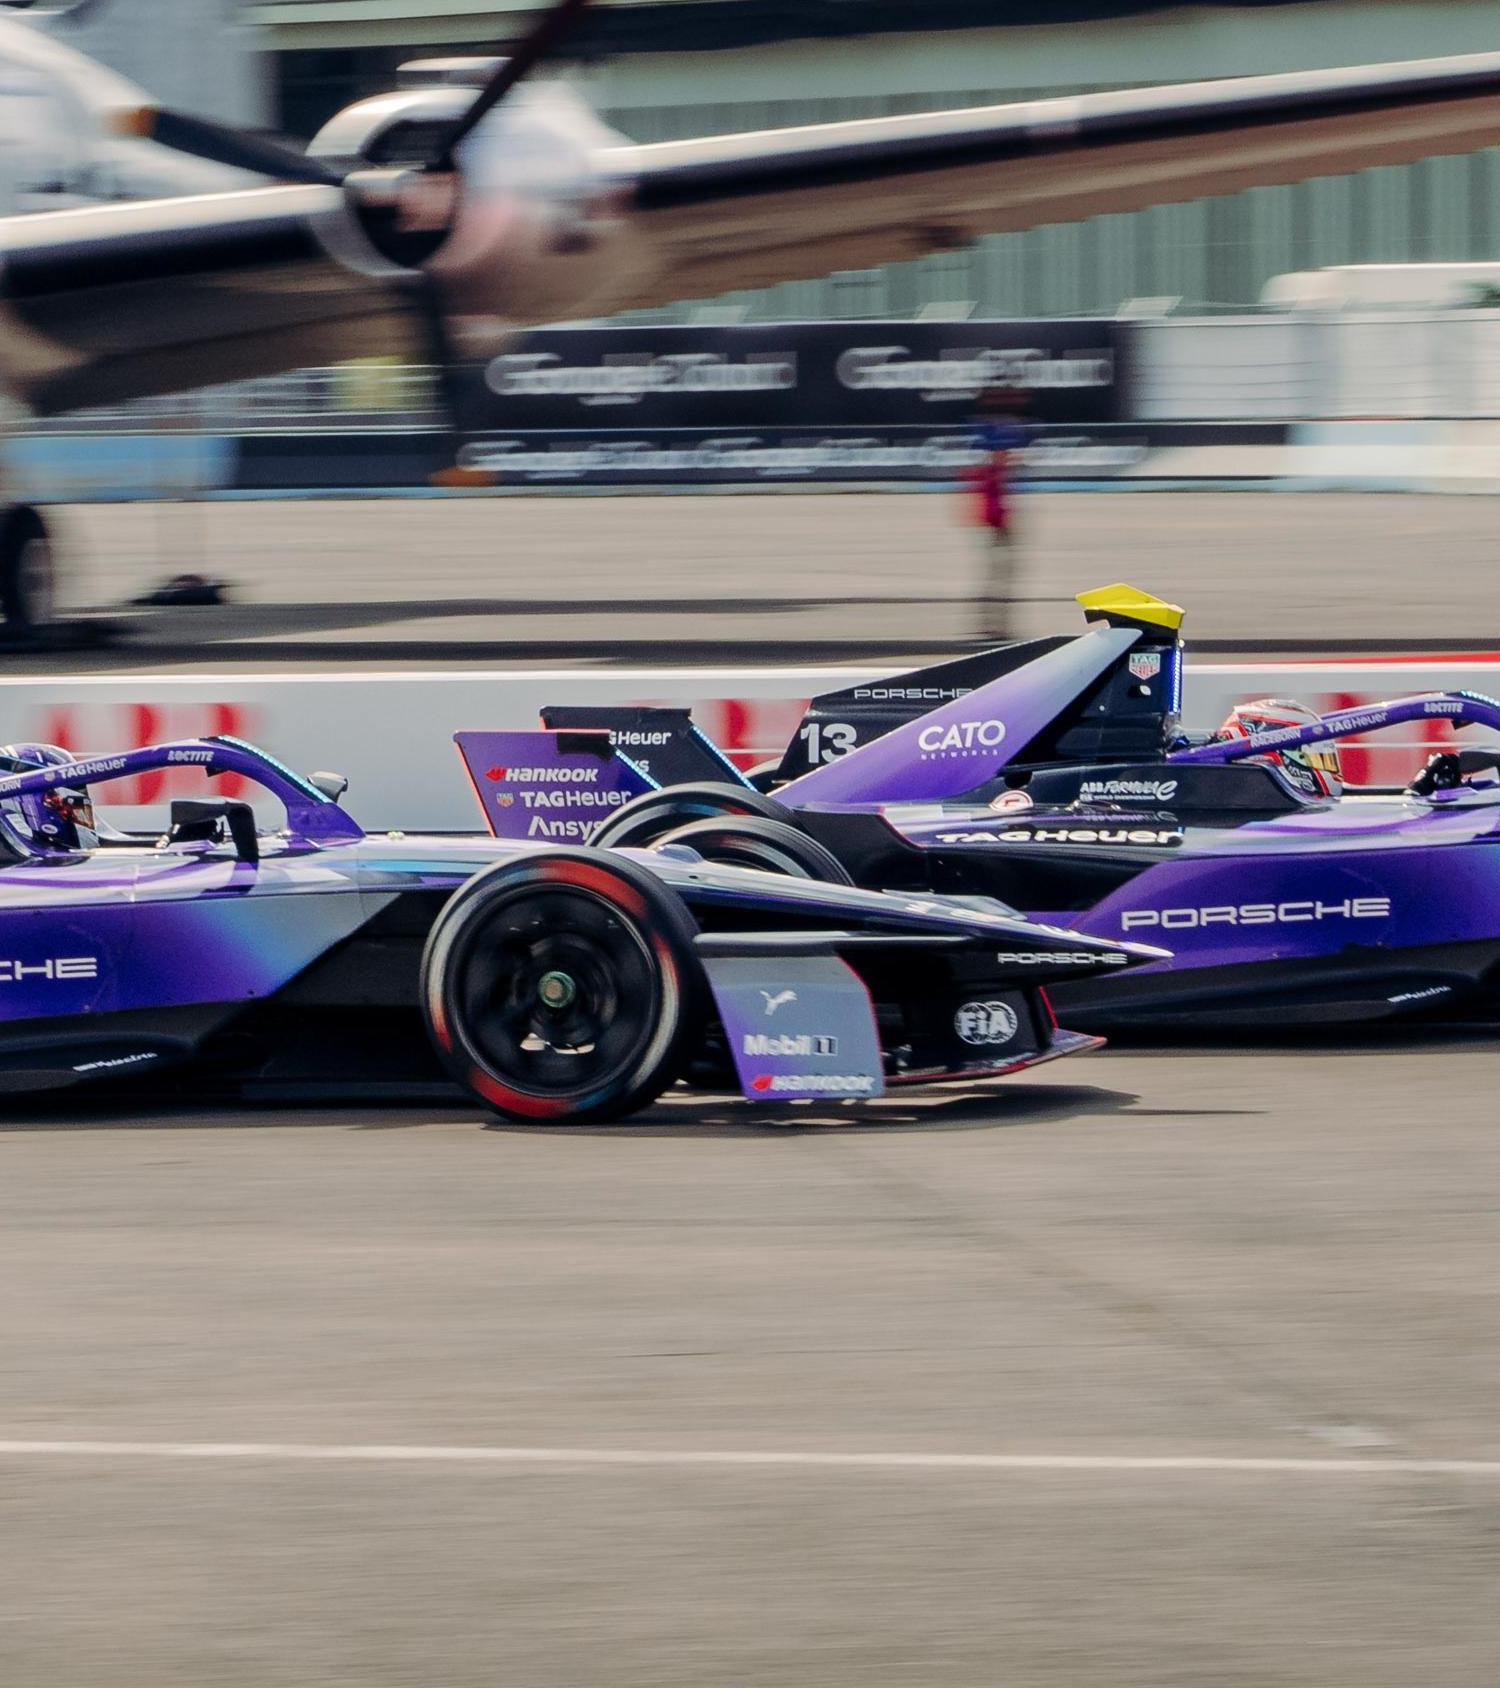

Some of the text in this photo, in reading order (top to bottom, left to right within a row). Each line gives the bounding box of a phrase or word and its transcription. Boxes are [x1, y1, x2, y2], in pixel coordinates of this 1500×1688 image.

[800, 722, 858, 763] 13
[918, 719, 1006, 751] CATO
[167, 750, 214, 762] LOCTITE
[1121, 897, 1391, 931] PORSCHE
[998, 952, 1128, 964] PORSCHE
[743, 1034, 811, 1056] Mobil
